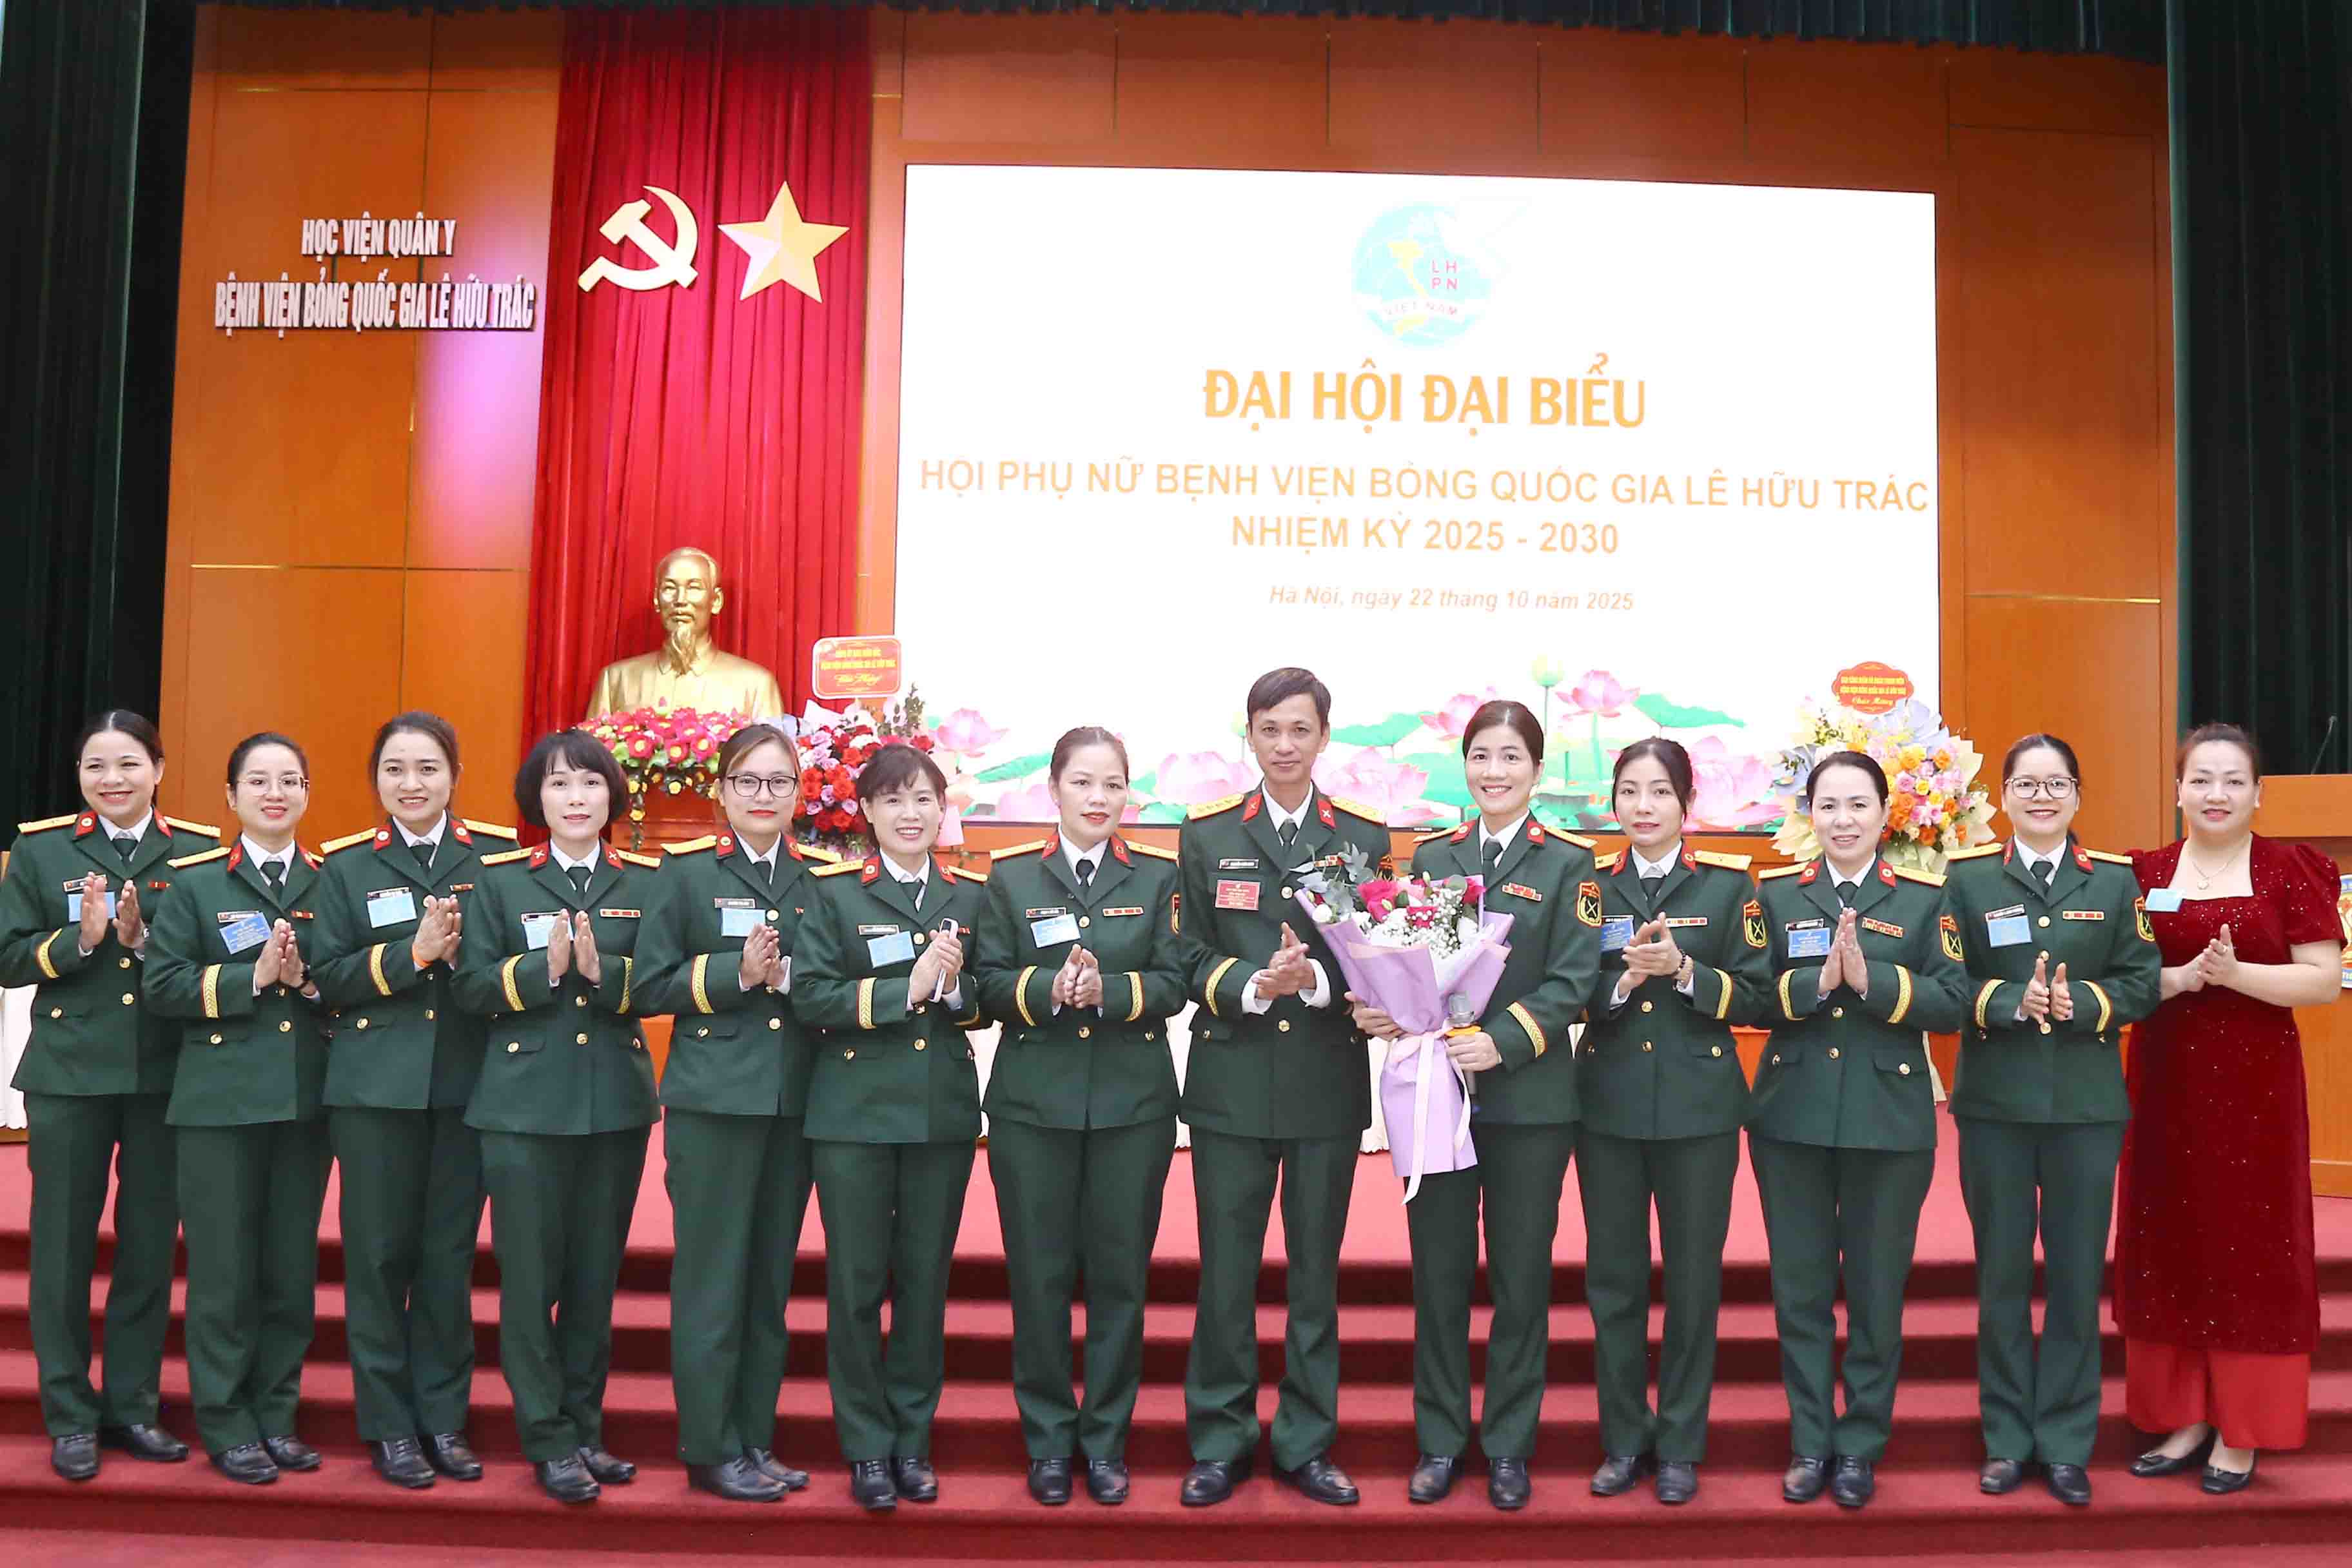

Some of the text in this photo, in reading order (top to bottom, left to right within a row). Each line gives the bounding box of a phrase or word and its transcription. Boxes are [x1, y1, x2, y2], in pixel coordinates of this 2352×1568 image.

[301, 211, 456, 263] HỌC VIỆN QUÂN Y
[215, 266, 535, 339] BỆNH VIỆN BỎNG QUỐC GIA LÊ HỮU TRÁC
[1202, 351, 1646, 438] ĐẠI HỘI ĐẠI BIỂU
[997, 459, 1073, 500] PHỤ
[1087, 455, 1144, 494] NỮ
[1610, 473, 1675, 505] GIA
[1685, 468, 1729, 506] LÊ
[1742, 470, 1821, 510] HỮU
[1833, 474, 1930, 513] TRÁC
[1423, 518, 1505, 552] 2025
[1538, 520, 1620, 555] 2030
[1409, 587, 1434, 607] 22
[1507, 589, 1529, 609] 10
[1587, 592, 1634, 610] 2025
